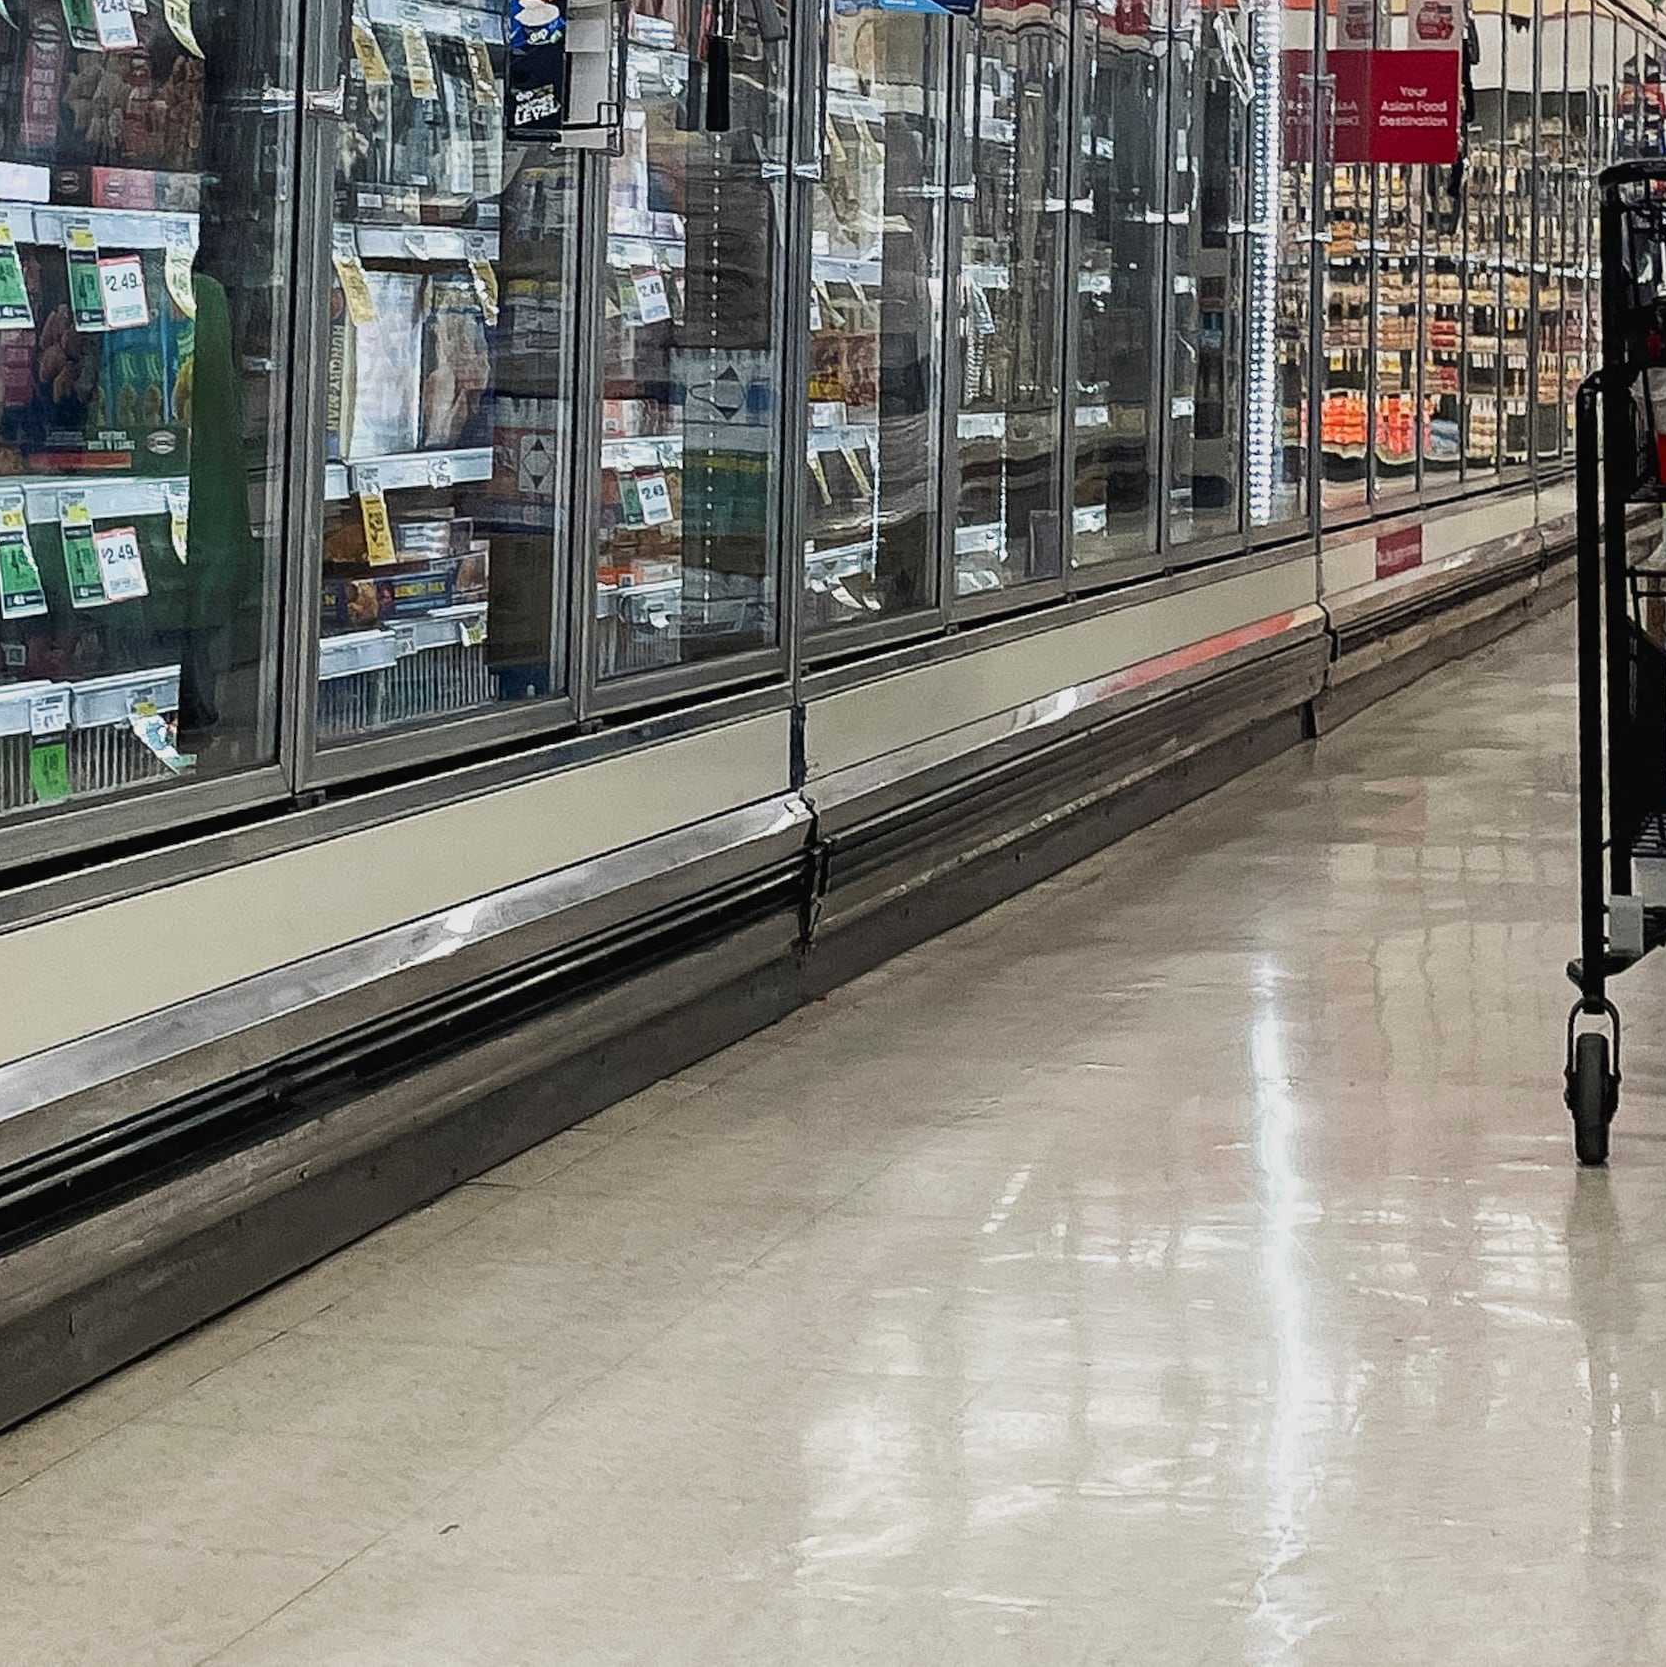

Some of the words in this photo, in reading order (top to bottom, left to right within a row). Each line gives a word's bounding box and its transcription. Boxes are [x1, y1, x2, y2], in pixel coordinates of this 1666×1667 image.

[1399, 85, 1428, 98] Your
[1380, 99, 1415, 113] Asian
[1416, 99, 1448, 113] Food
[514, 100, 558, 127] LEVEL
[1379, 113, 1449, 128] Destination
